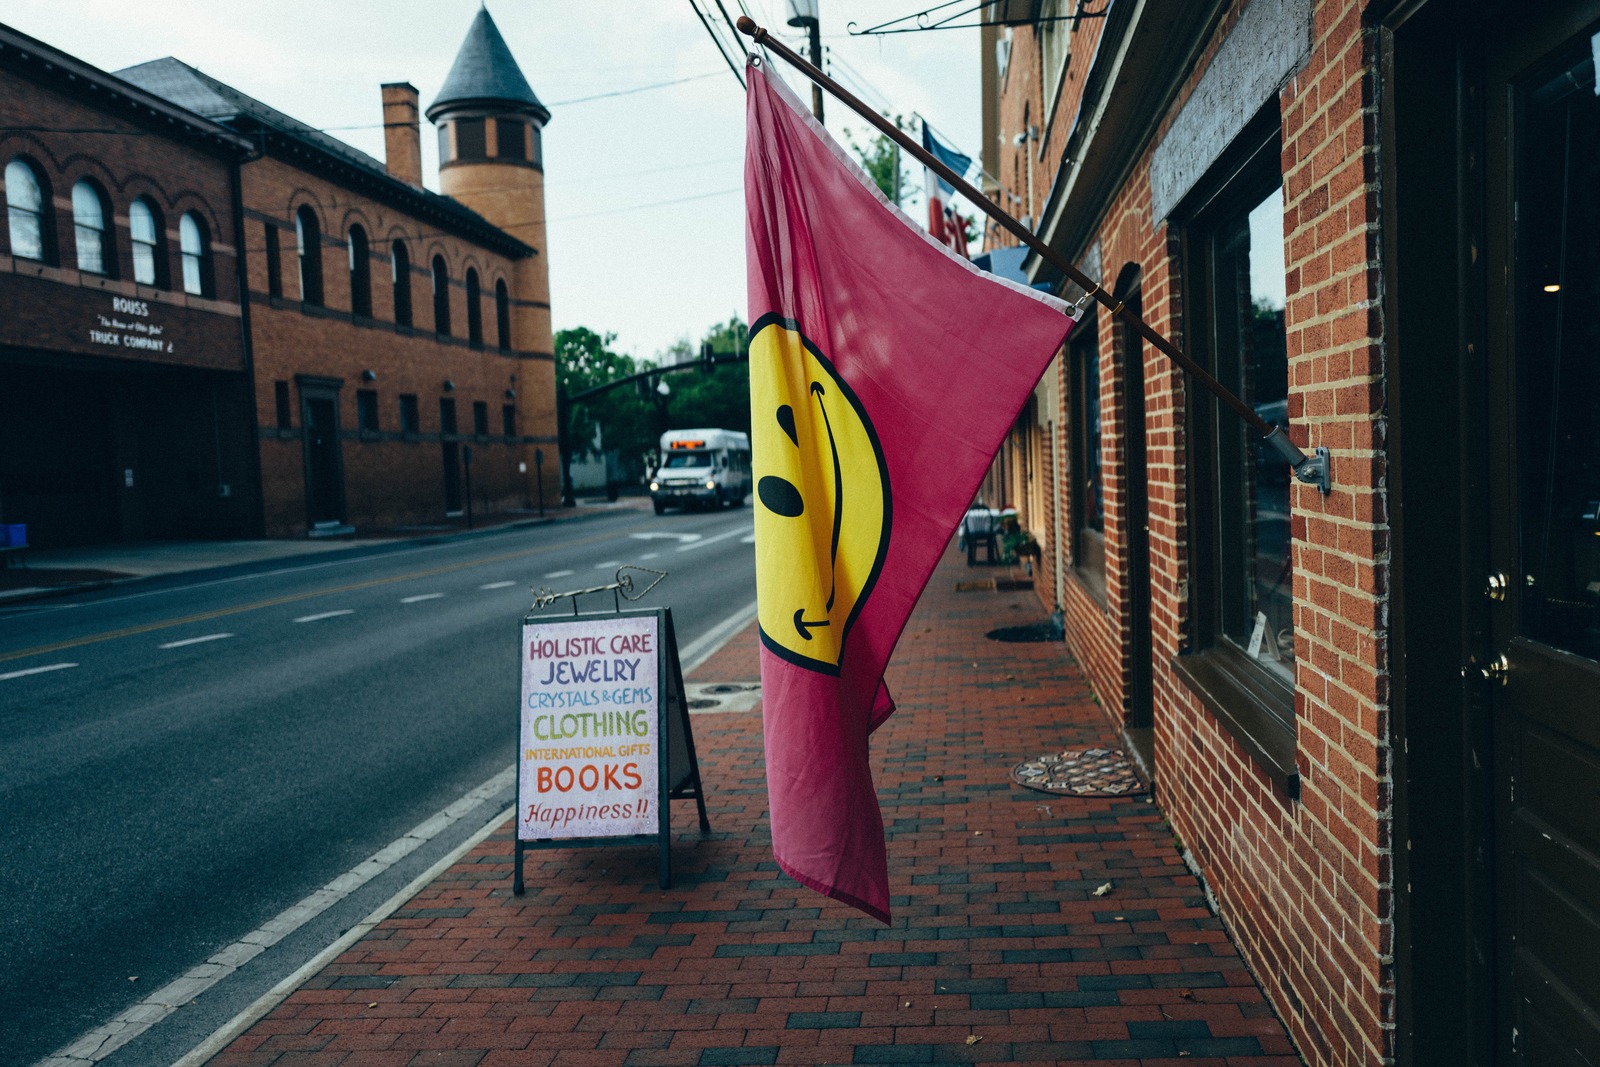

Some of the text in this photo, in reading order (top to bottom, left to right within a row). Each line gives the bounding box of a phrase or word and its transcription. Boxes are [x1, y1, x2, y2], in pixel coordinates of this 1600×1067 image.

[113, 297, 149, 316] ROUSS
[90, 330, 119, 345] TRUCK
[124, 335, 163, 351] COMPANY
[530, 634, 653, 660] HOLISTIC CARE
[540, 658, 641, 686] JEWELRY
[533, 709, 649, 740] CLOTHING
[525, 743, 651, 760] INTERNATIONAL GIFTS
[537, 762, 642, 793] BOOKS
[524, 799, 649, 829] Happiness!!
